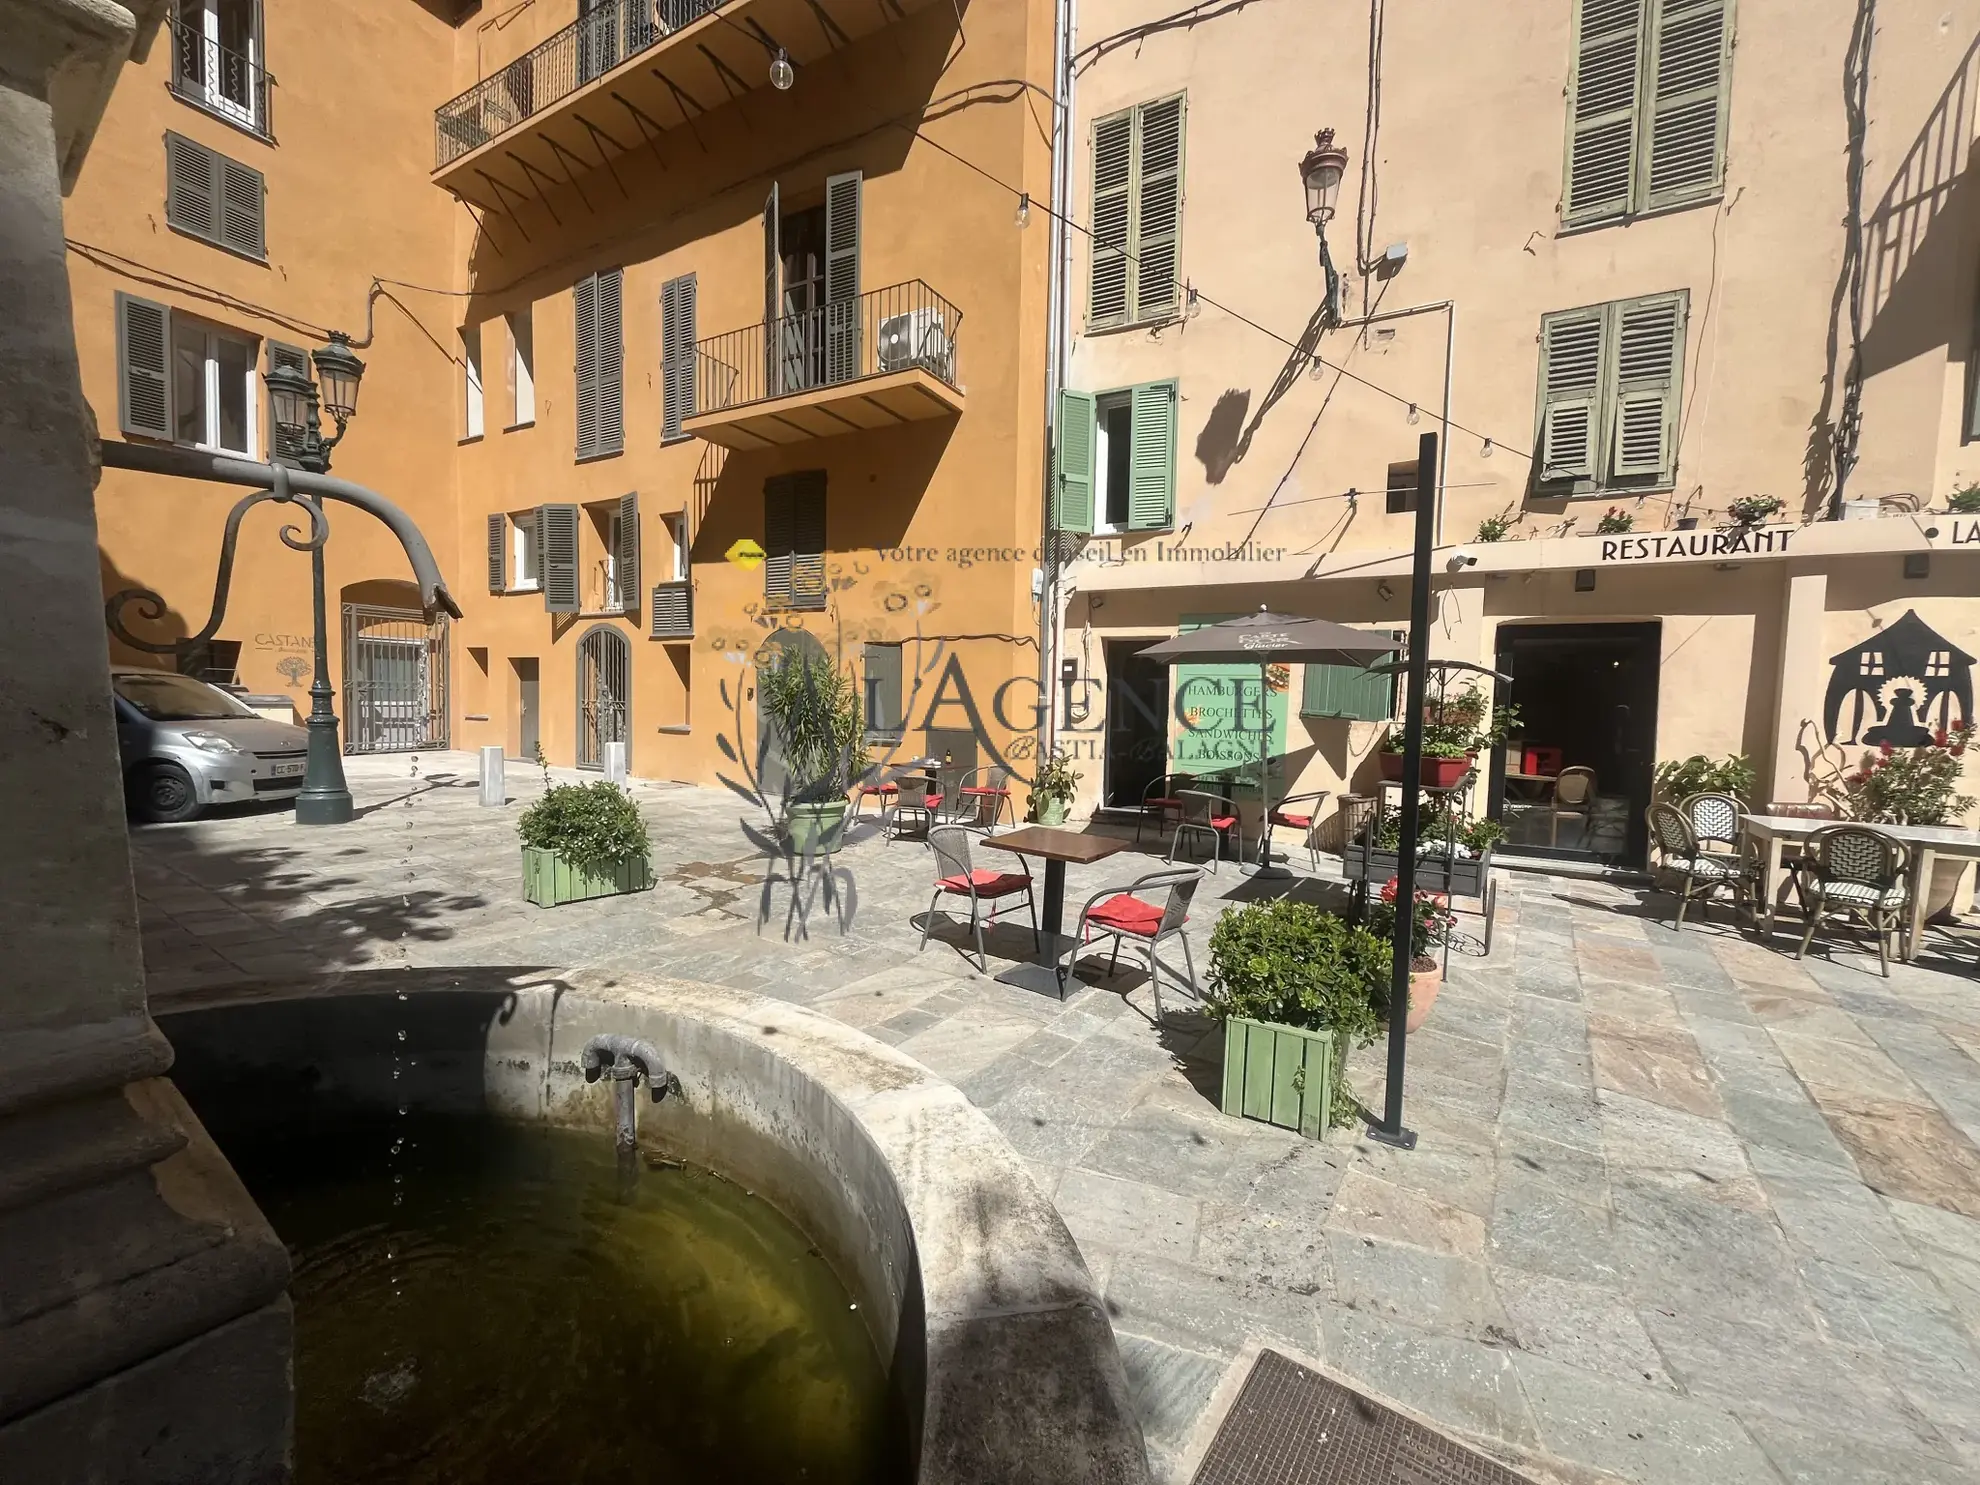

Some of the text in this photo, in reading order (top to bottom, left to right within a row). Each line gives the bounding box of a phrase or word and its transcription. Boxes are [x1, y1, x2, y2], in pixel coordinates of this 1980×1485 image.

[1952, 520, 1980, 544] LA
[1601, 529, 1795, 561] RESTAURANT
[1198, 748, 1260, 763] BOISSONS
